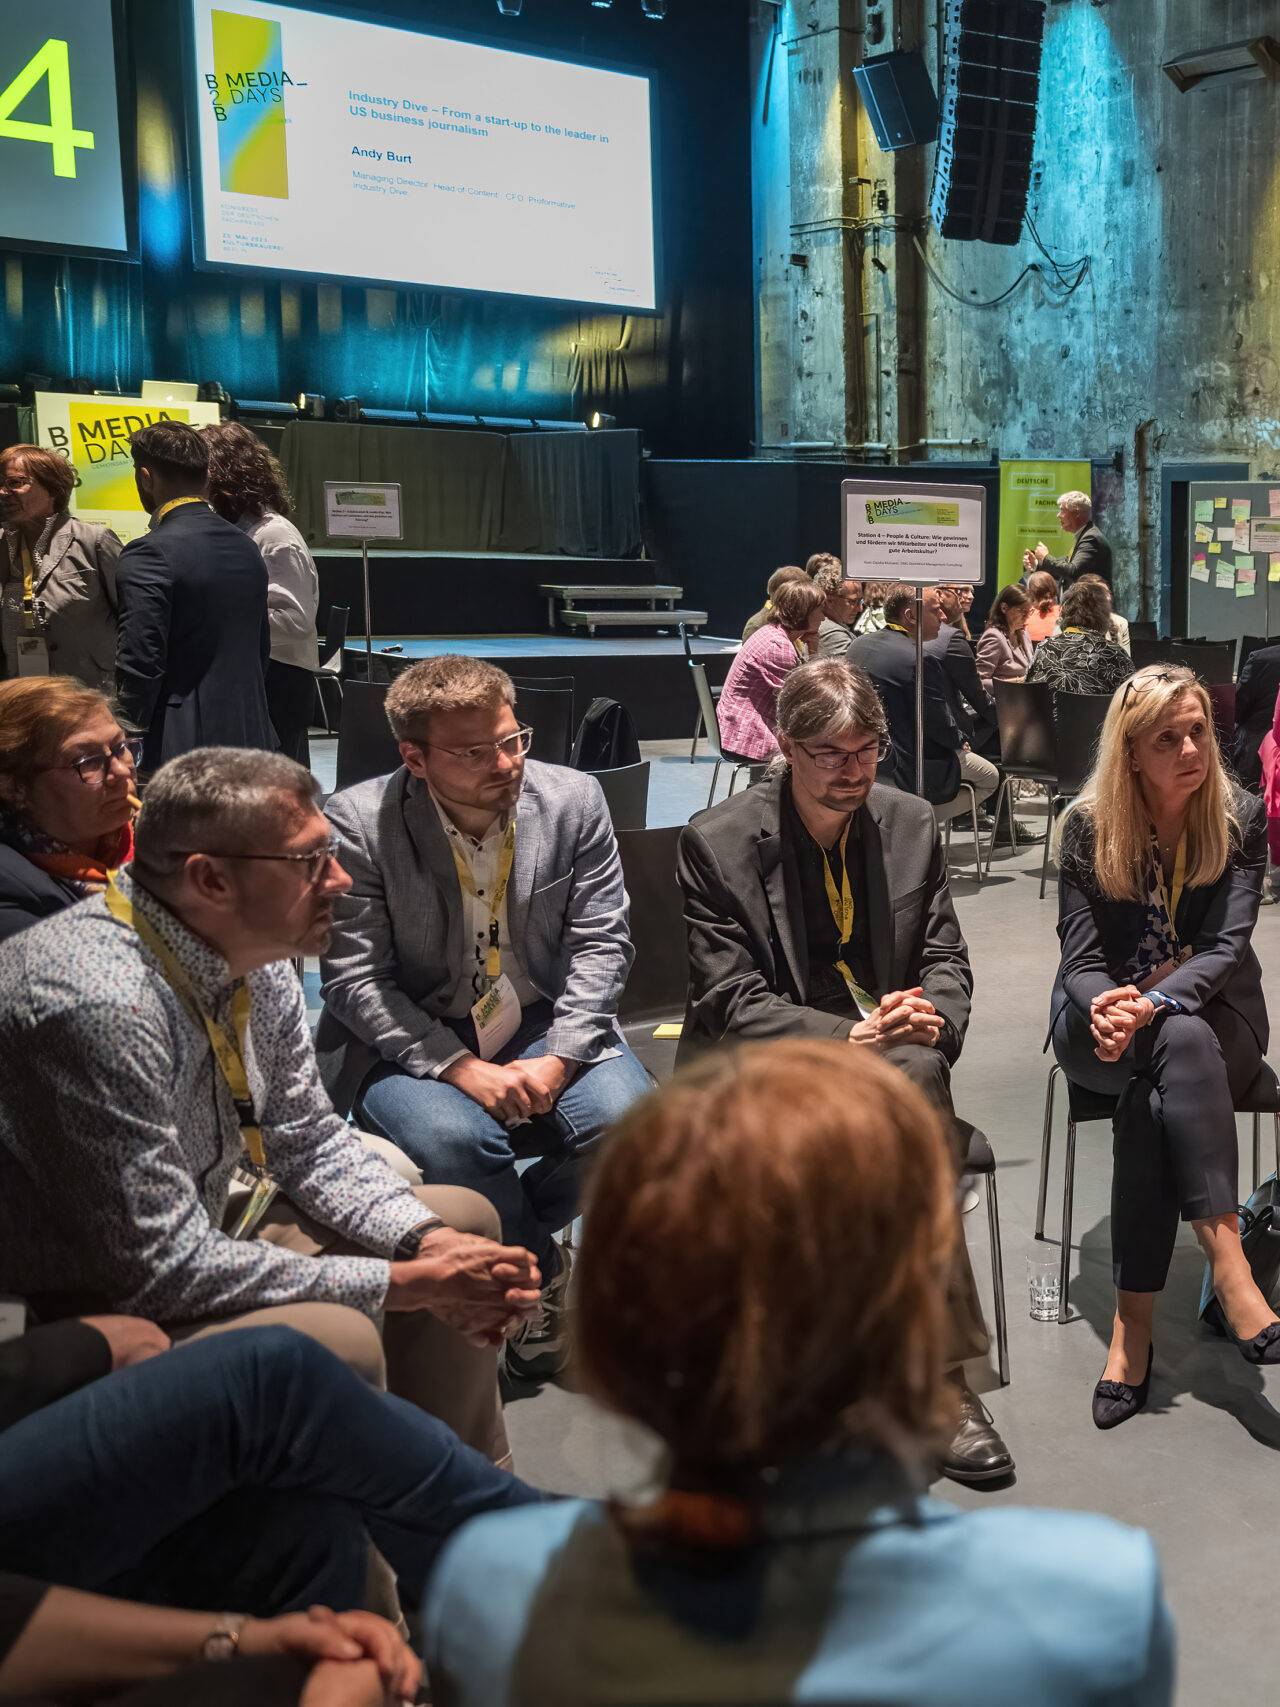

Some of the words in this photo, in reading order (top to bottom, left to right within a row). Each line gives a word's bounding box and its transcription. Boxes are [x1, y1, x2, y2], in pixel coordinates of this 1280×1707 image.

[230, 88, 281, 104] DAYS
[0, 38, 95, 179] 4
[348, 89, 399, 109] Industry
[402, 99, 428, 113] Dive
[442, 106, 472, 122] From
[485, 115, 529, 131] start-up
[531, 122, 542, 132] to
[544, 123, 561, 136] the
[564, 127, 597, 142] leader
[600, 134, 609, 144] in
[348, 105, 368, 117] US
[371, 108, 425, 127] business
[428, 117, 489, 138] journalism
[351, 145, 383, 161] Andy
[386, 151, 412, 164] Burt
[352, 170, 394, 185] Managing
[875, 505, 899, 517] DAYS
